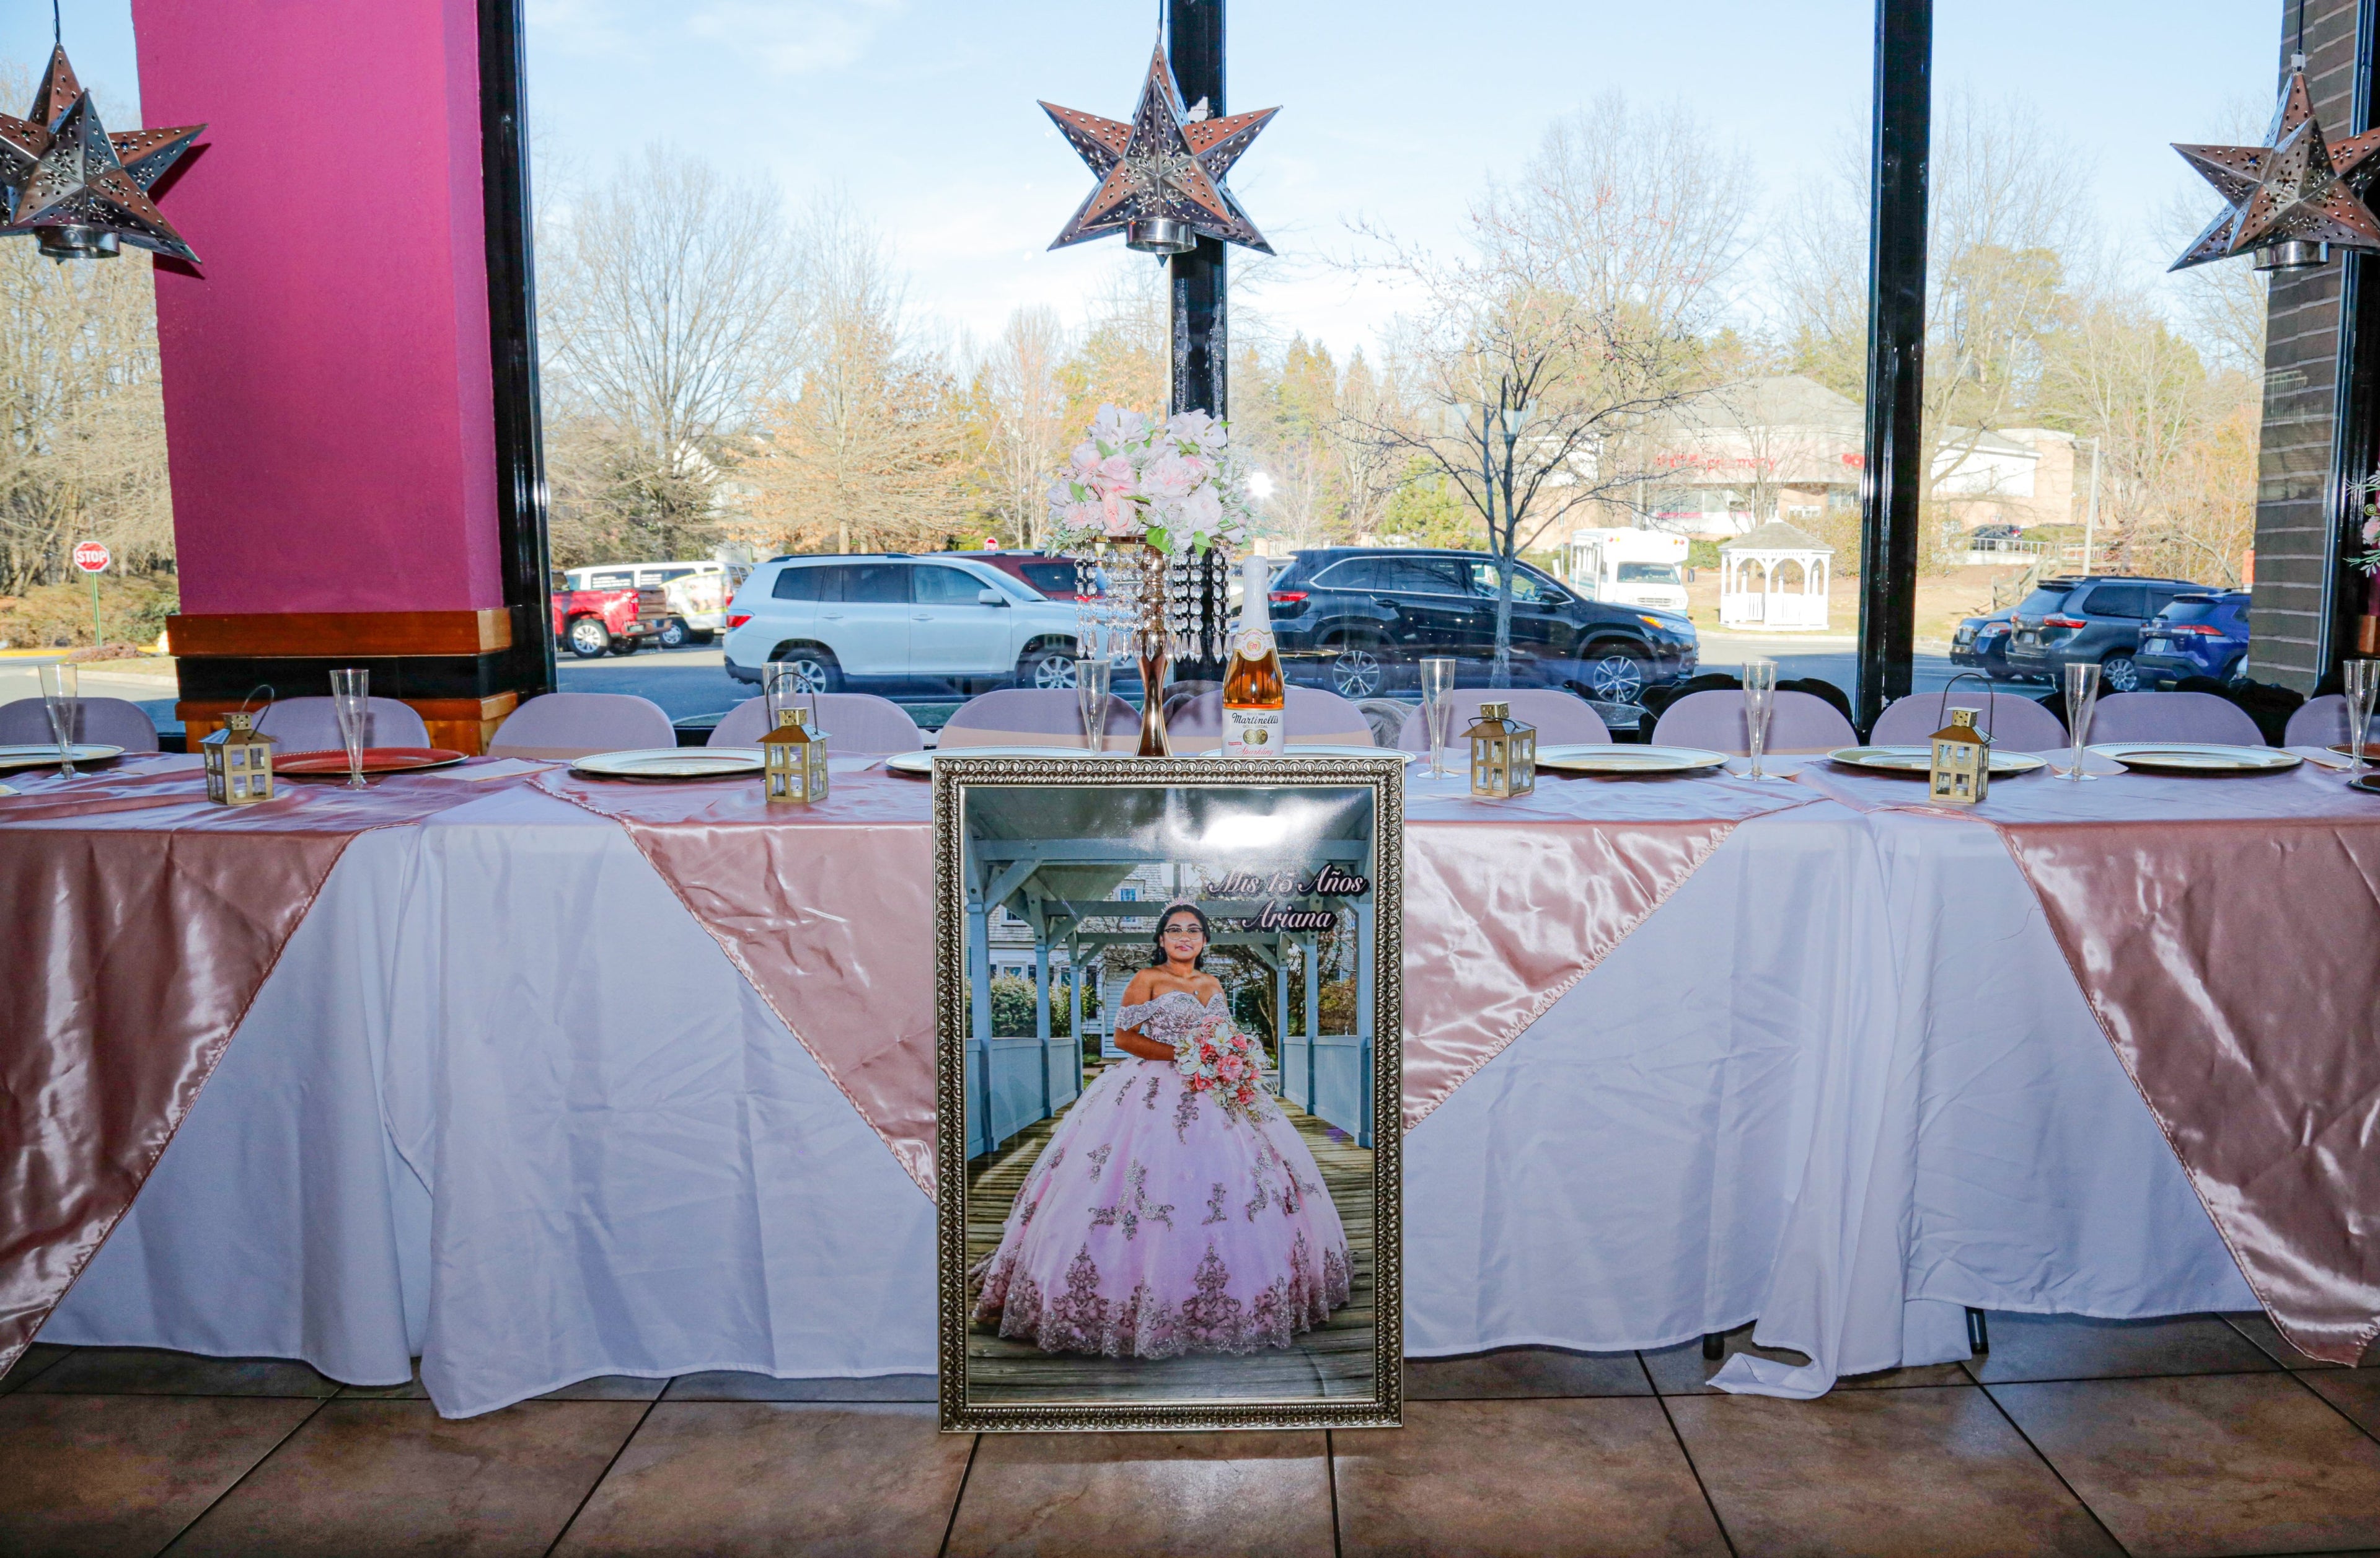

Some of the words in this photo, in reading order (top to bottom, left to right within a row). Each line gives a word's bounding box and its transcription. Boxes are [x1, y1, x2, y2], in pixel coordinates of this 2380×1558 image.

[76, 550, 107, 563] STOP
[1235, 745, 1274, 757] Sparkling
[1208, 868, 1260, 893] Mis
[1265, 871, 1297, 893] 15
[1298, 864, 1367, 894] Años
[1241, 900, 1337, 928] Ariana
